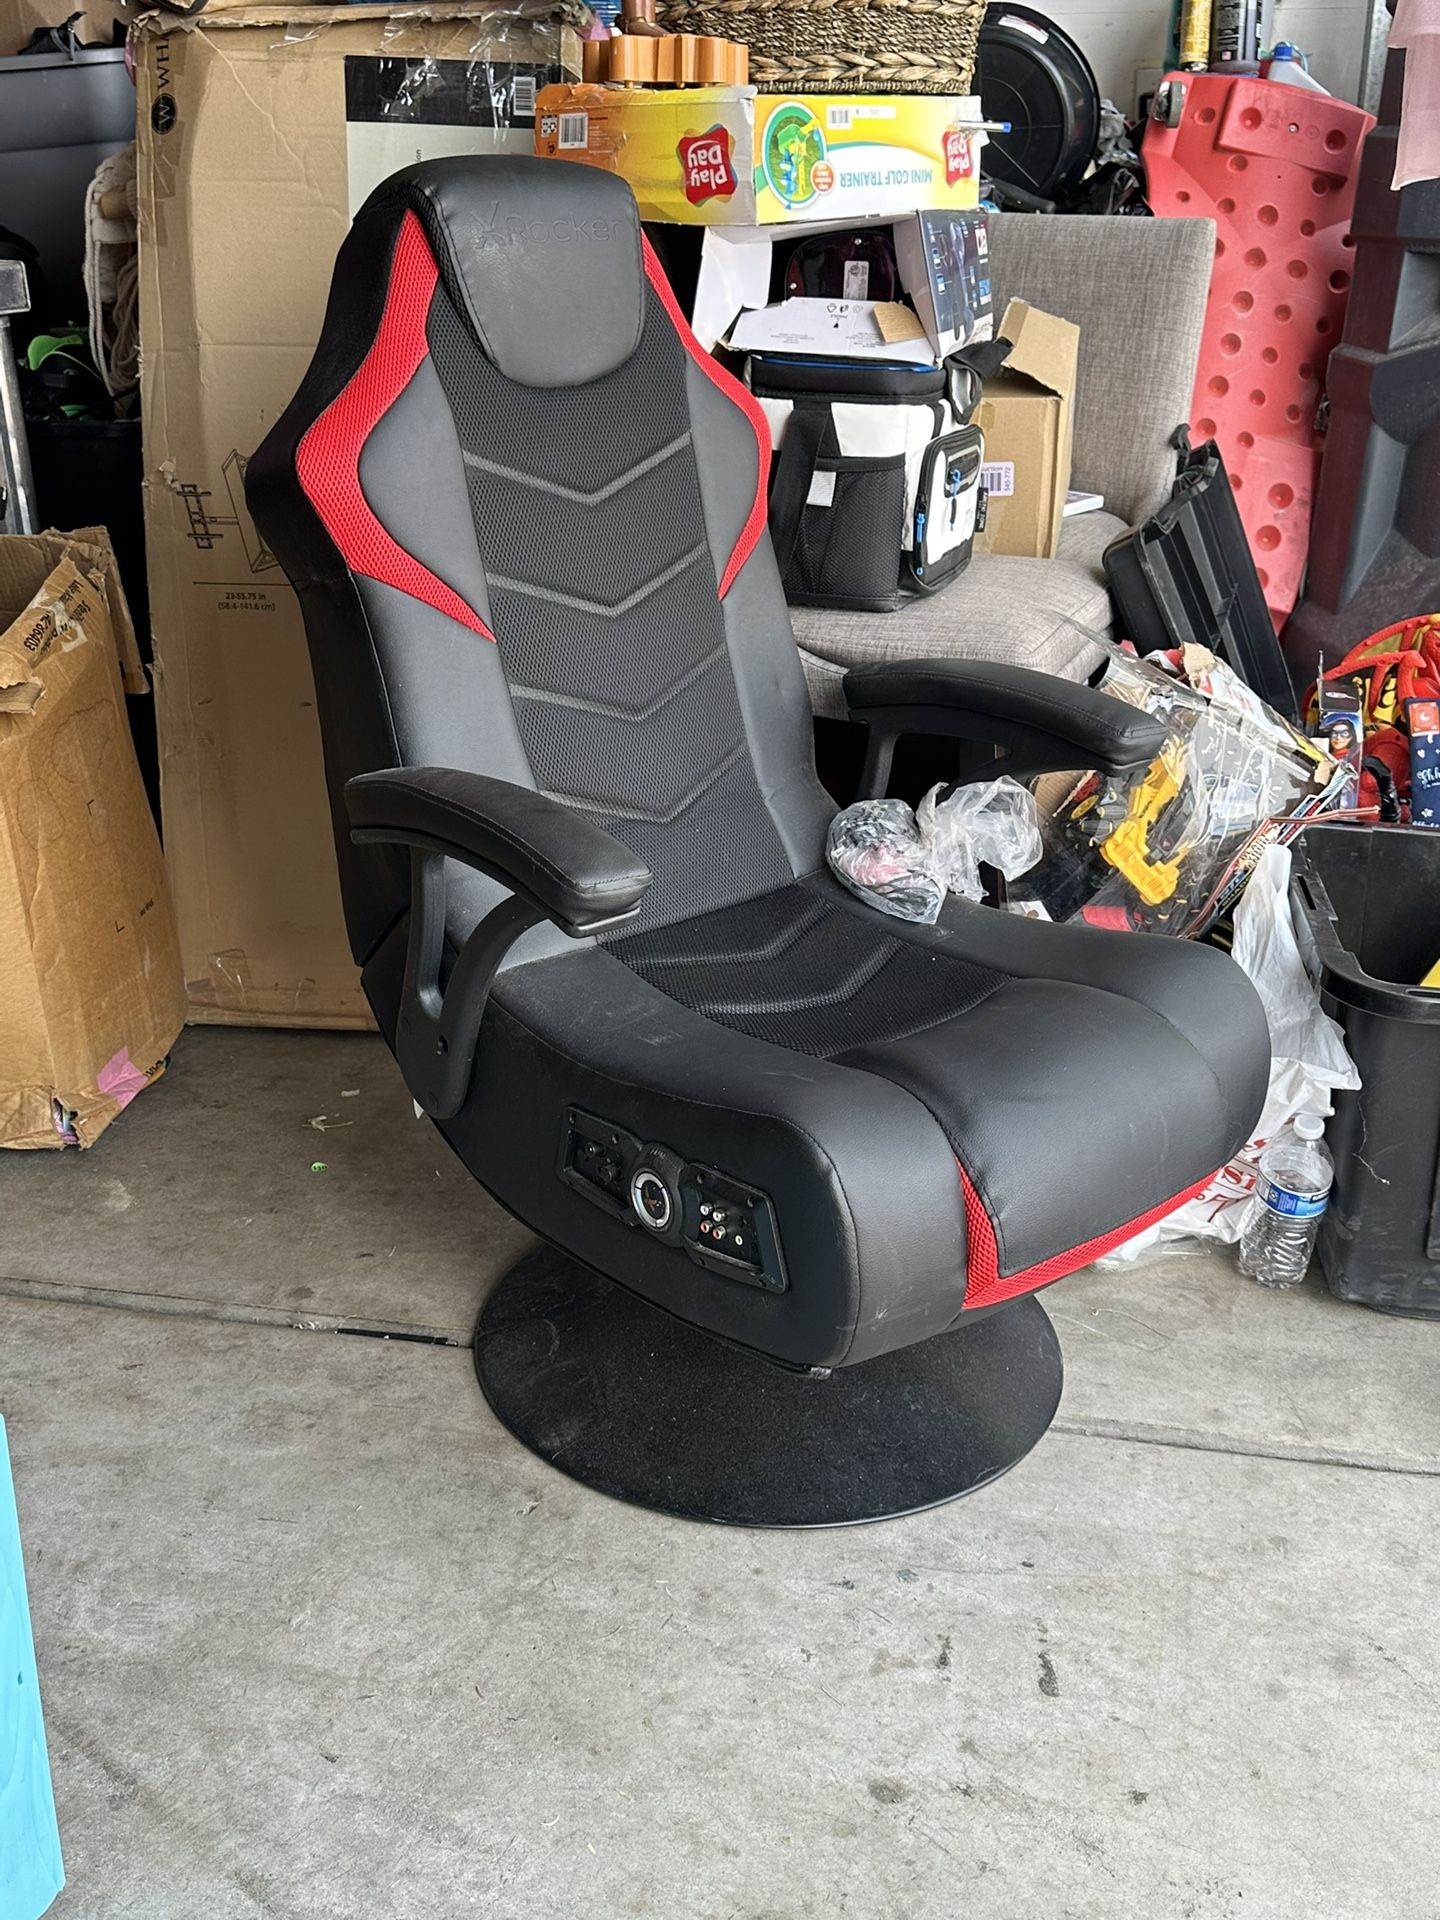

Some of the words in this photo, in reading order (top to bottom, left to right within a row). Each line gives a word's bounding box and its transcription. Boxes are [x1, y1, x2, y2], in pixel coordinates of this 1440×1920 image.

[687, 140, 723, 168] Day
[948, 155, 971, 174] Play
[689, 165, 728, 190] Play
[839, 171, 883, 188] TRAINER
[885, 170, 908, 185] GOLF
[911, 169, 933, 183] MINI
